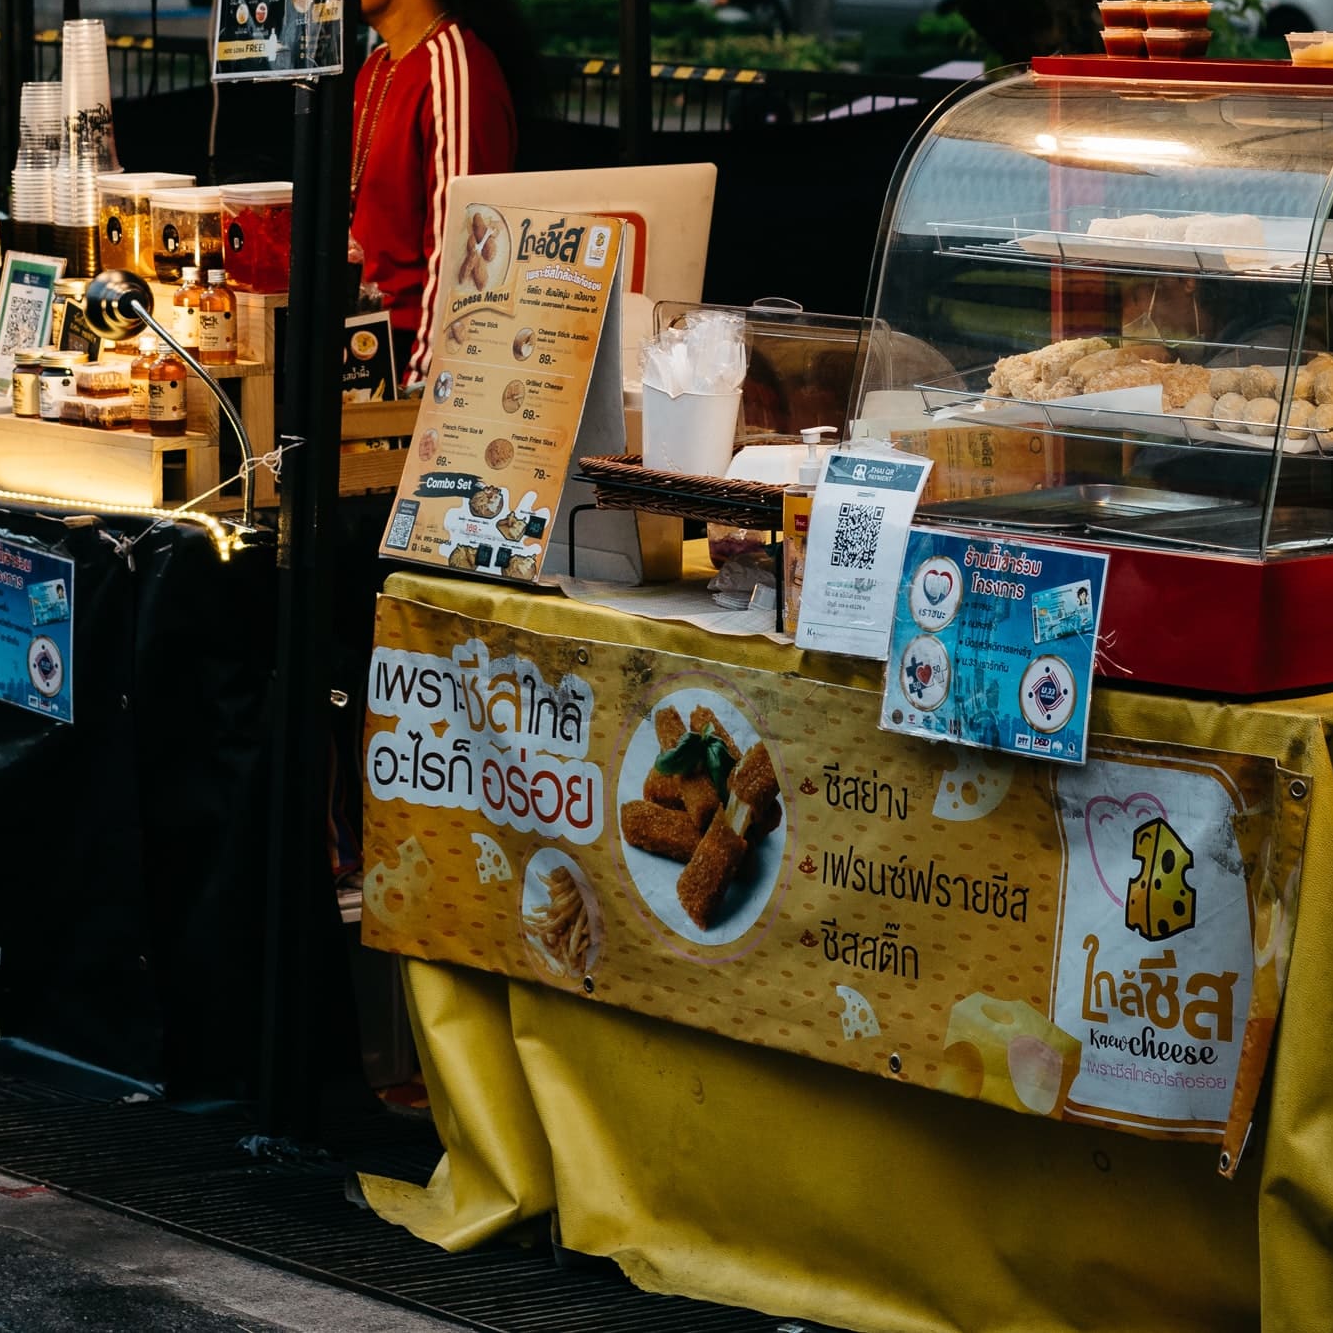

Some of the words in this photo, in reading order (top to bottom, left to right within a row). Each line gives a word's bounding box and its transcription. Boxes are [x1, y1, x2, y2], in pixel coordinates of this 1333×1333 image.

[516, 216, 587, 265] ใกล้ชีส
[451, 292, 483, 313] Cheese
[484, 289, 510, 304] Menu
[538, 328, 557, 338] Cheese
[557, 330, 571, 339] Stick
[571, 332, 590, 341] Jumbo
[467, 344, 482, 355] 69.-
[538, 353, 557, 365] 89.-
[544, 382, 564, 392] Cheese
[453, 397, 469, 408] 69.-
[522, 409, 540, 420] 69.-
[511, 433, 528, 443] French
[529, 435, 542, 445] Fries
[436, 456, 452, 467] 69.-
[533, 468, 551, 480] 79.-
[426, 477, 456, 490] Combo
[457, 479, 472, 491] Set
[965, 544, 1043, 577] ร้านนี้เข้าร่วม
[971, 573, 1026, 600] โครงการ
[918, 607, 947, 620] เราชนะ
[1040, 686, 1056, 695] ม.33
[1034, 738, 1050, 746] DBD
[373, 729, 473, 796] อะไรก็
[481, 748, 594, 830] อร่อย
[822, 762, 908, 821] ชีสย่าง
[820, 918, 919, 980] ชีสสติ๊ก
[1081, 933, 1240, 1043] ใกล้ชีส
